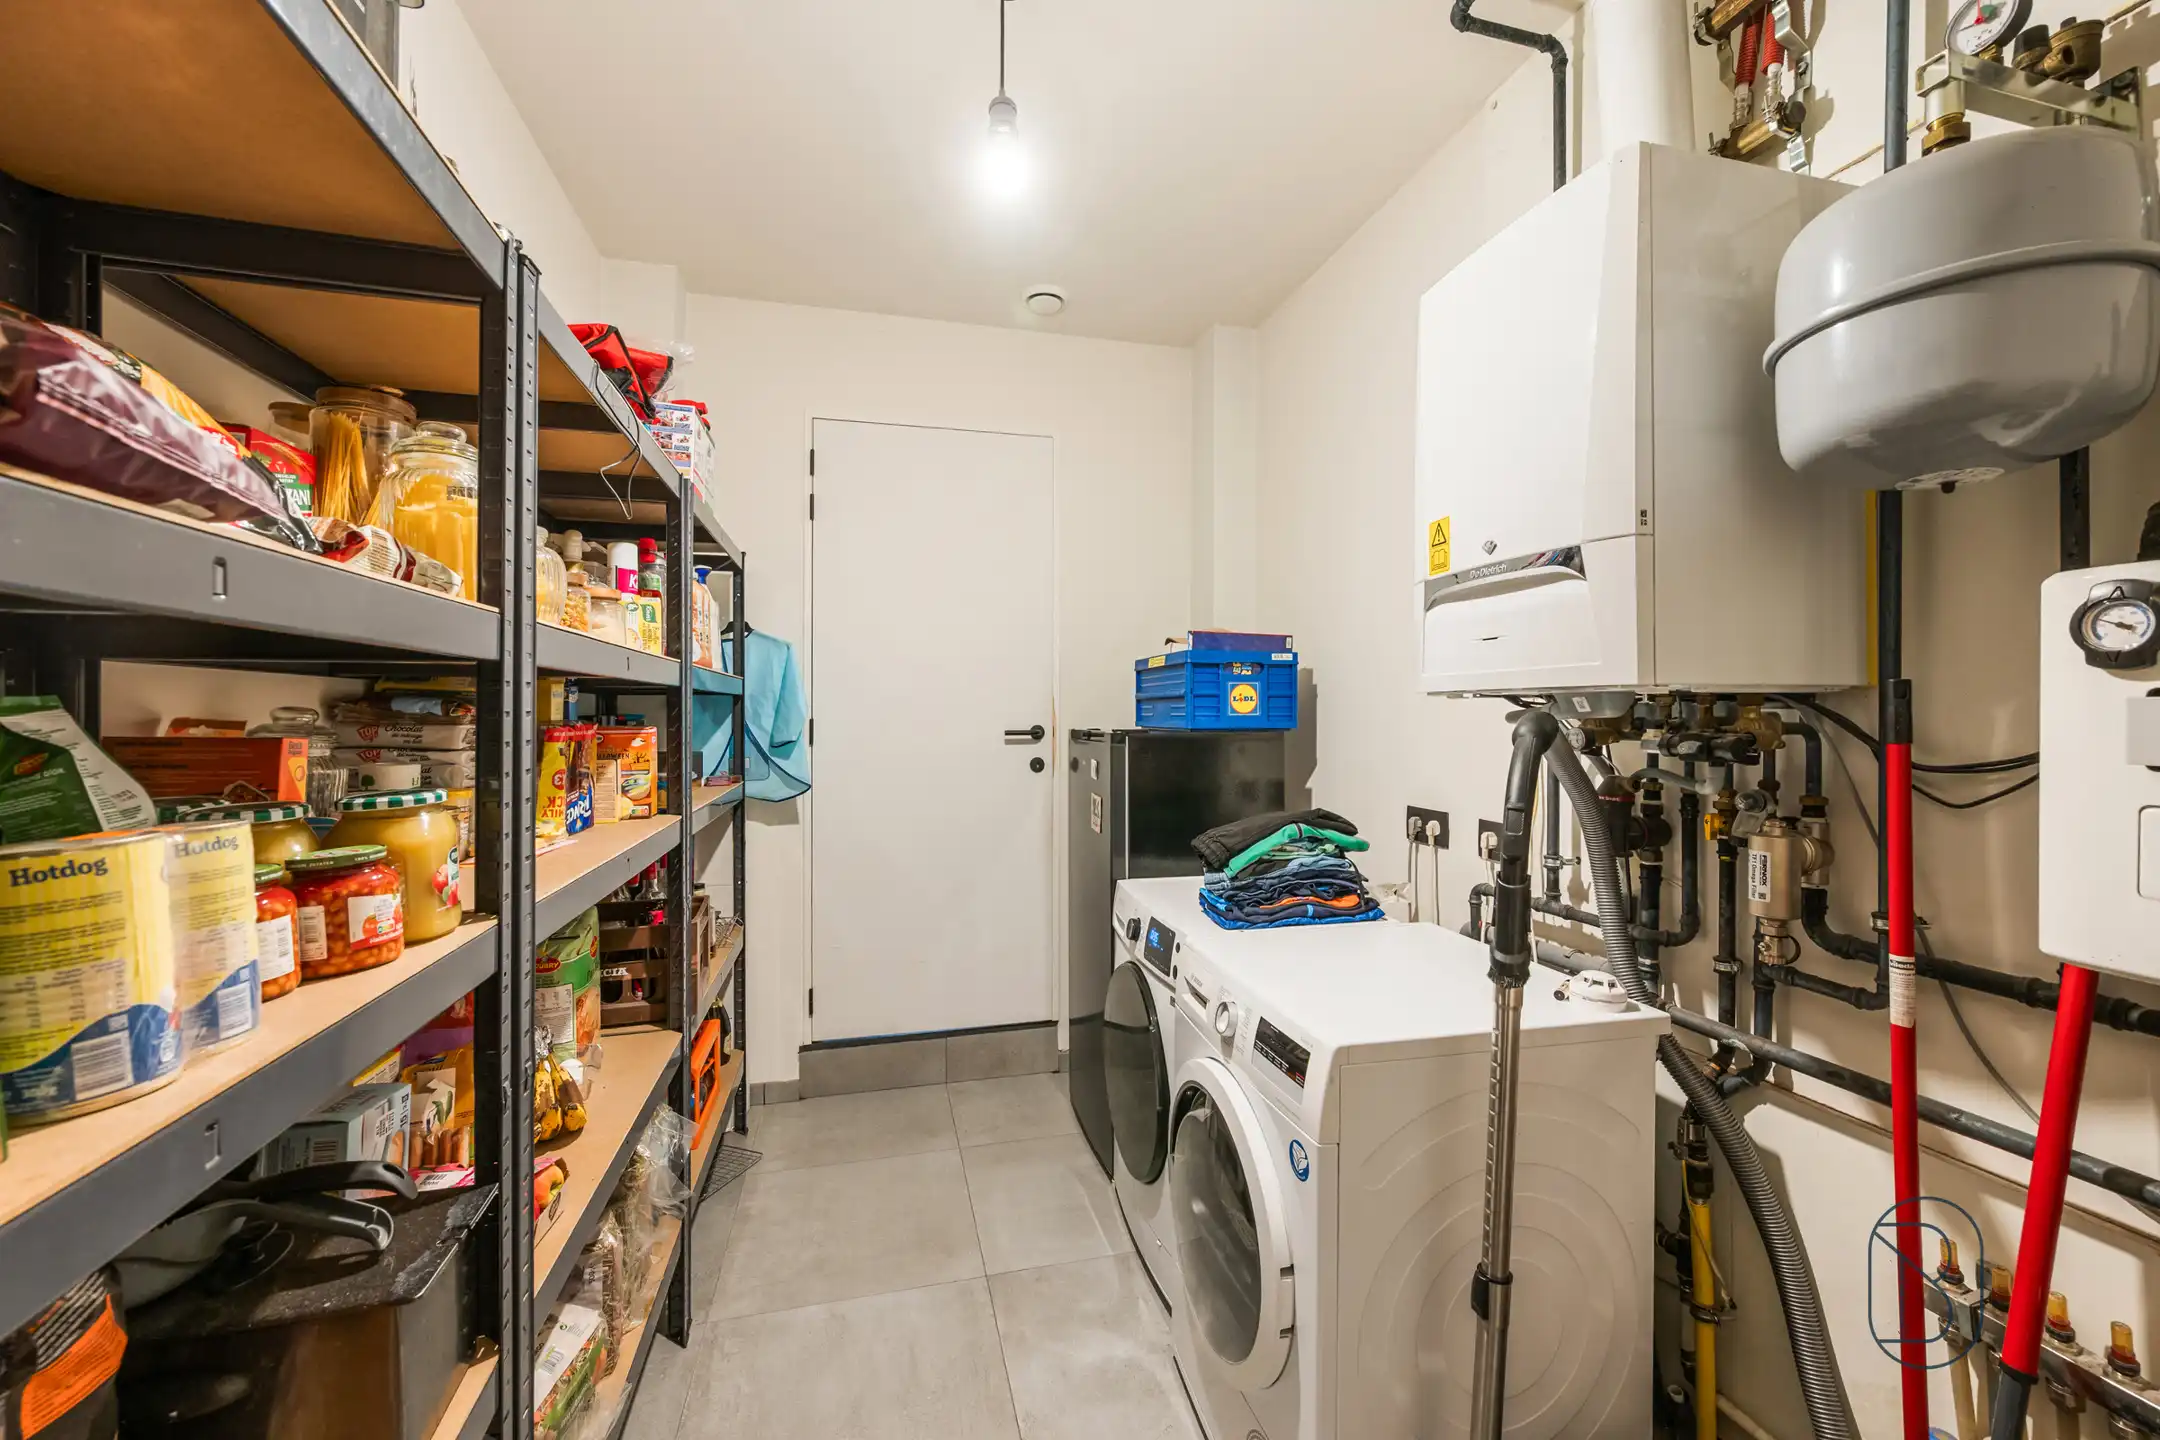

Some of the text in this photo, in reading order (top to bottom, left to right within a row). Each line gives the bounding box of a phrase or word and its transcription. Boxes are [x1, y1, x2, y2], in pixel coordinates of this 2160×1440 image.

[360, 725, 380, 741] TOP
[384, 722, 424, 733] Chocolat
[174, 835, 240, 859] Hotdog
[8, 857, 109, 888] Hotdog
